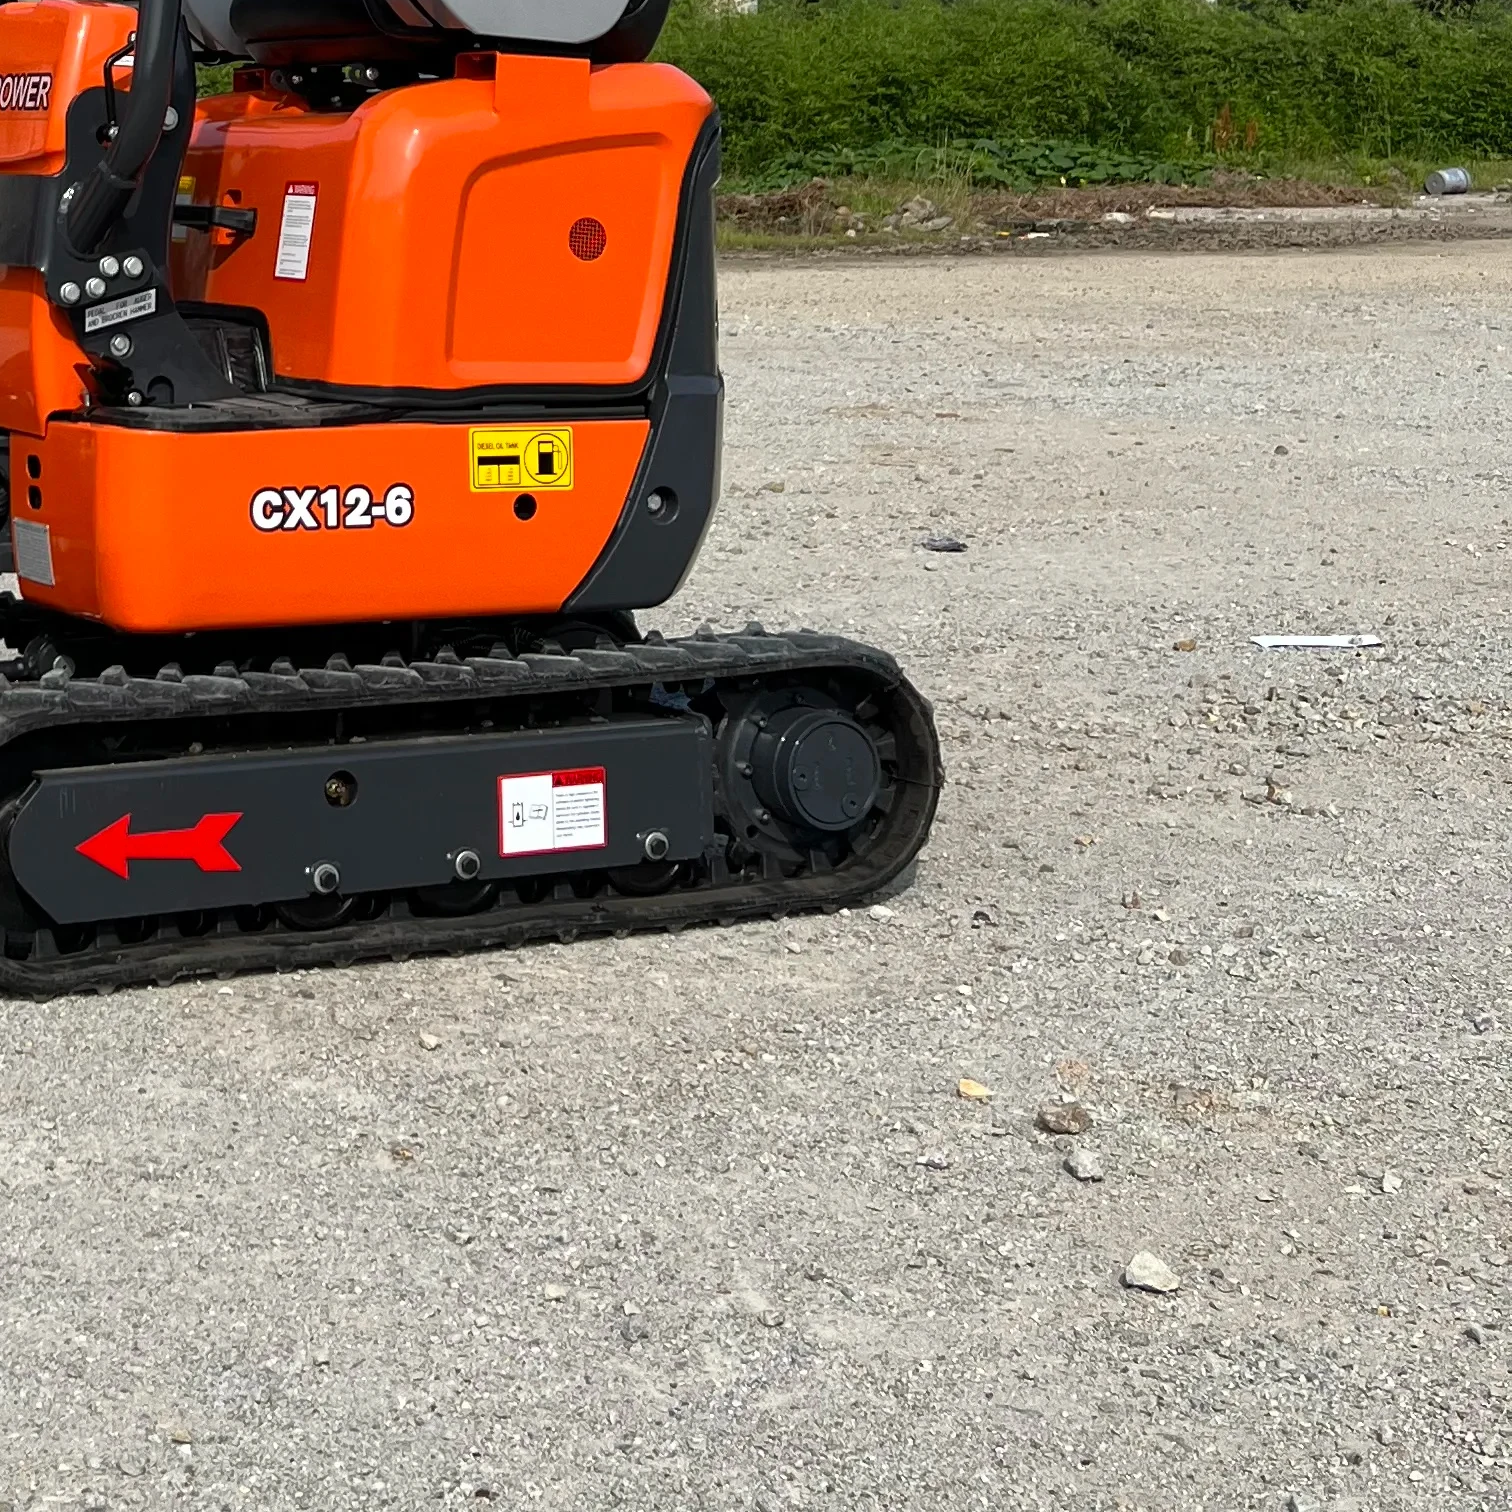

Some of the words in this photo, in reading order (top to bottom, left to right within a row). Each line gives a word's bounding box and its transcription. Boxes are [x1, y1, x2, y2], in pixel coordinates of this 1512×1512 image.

[87, 308, 105, 318] PEDAL
[116, 300, 128, 310] FOR
[88, 318, 100, 328] AND
[477, 442, 495, 450] DIESEL
[249, 483, 415, 532] CX12-6
